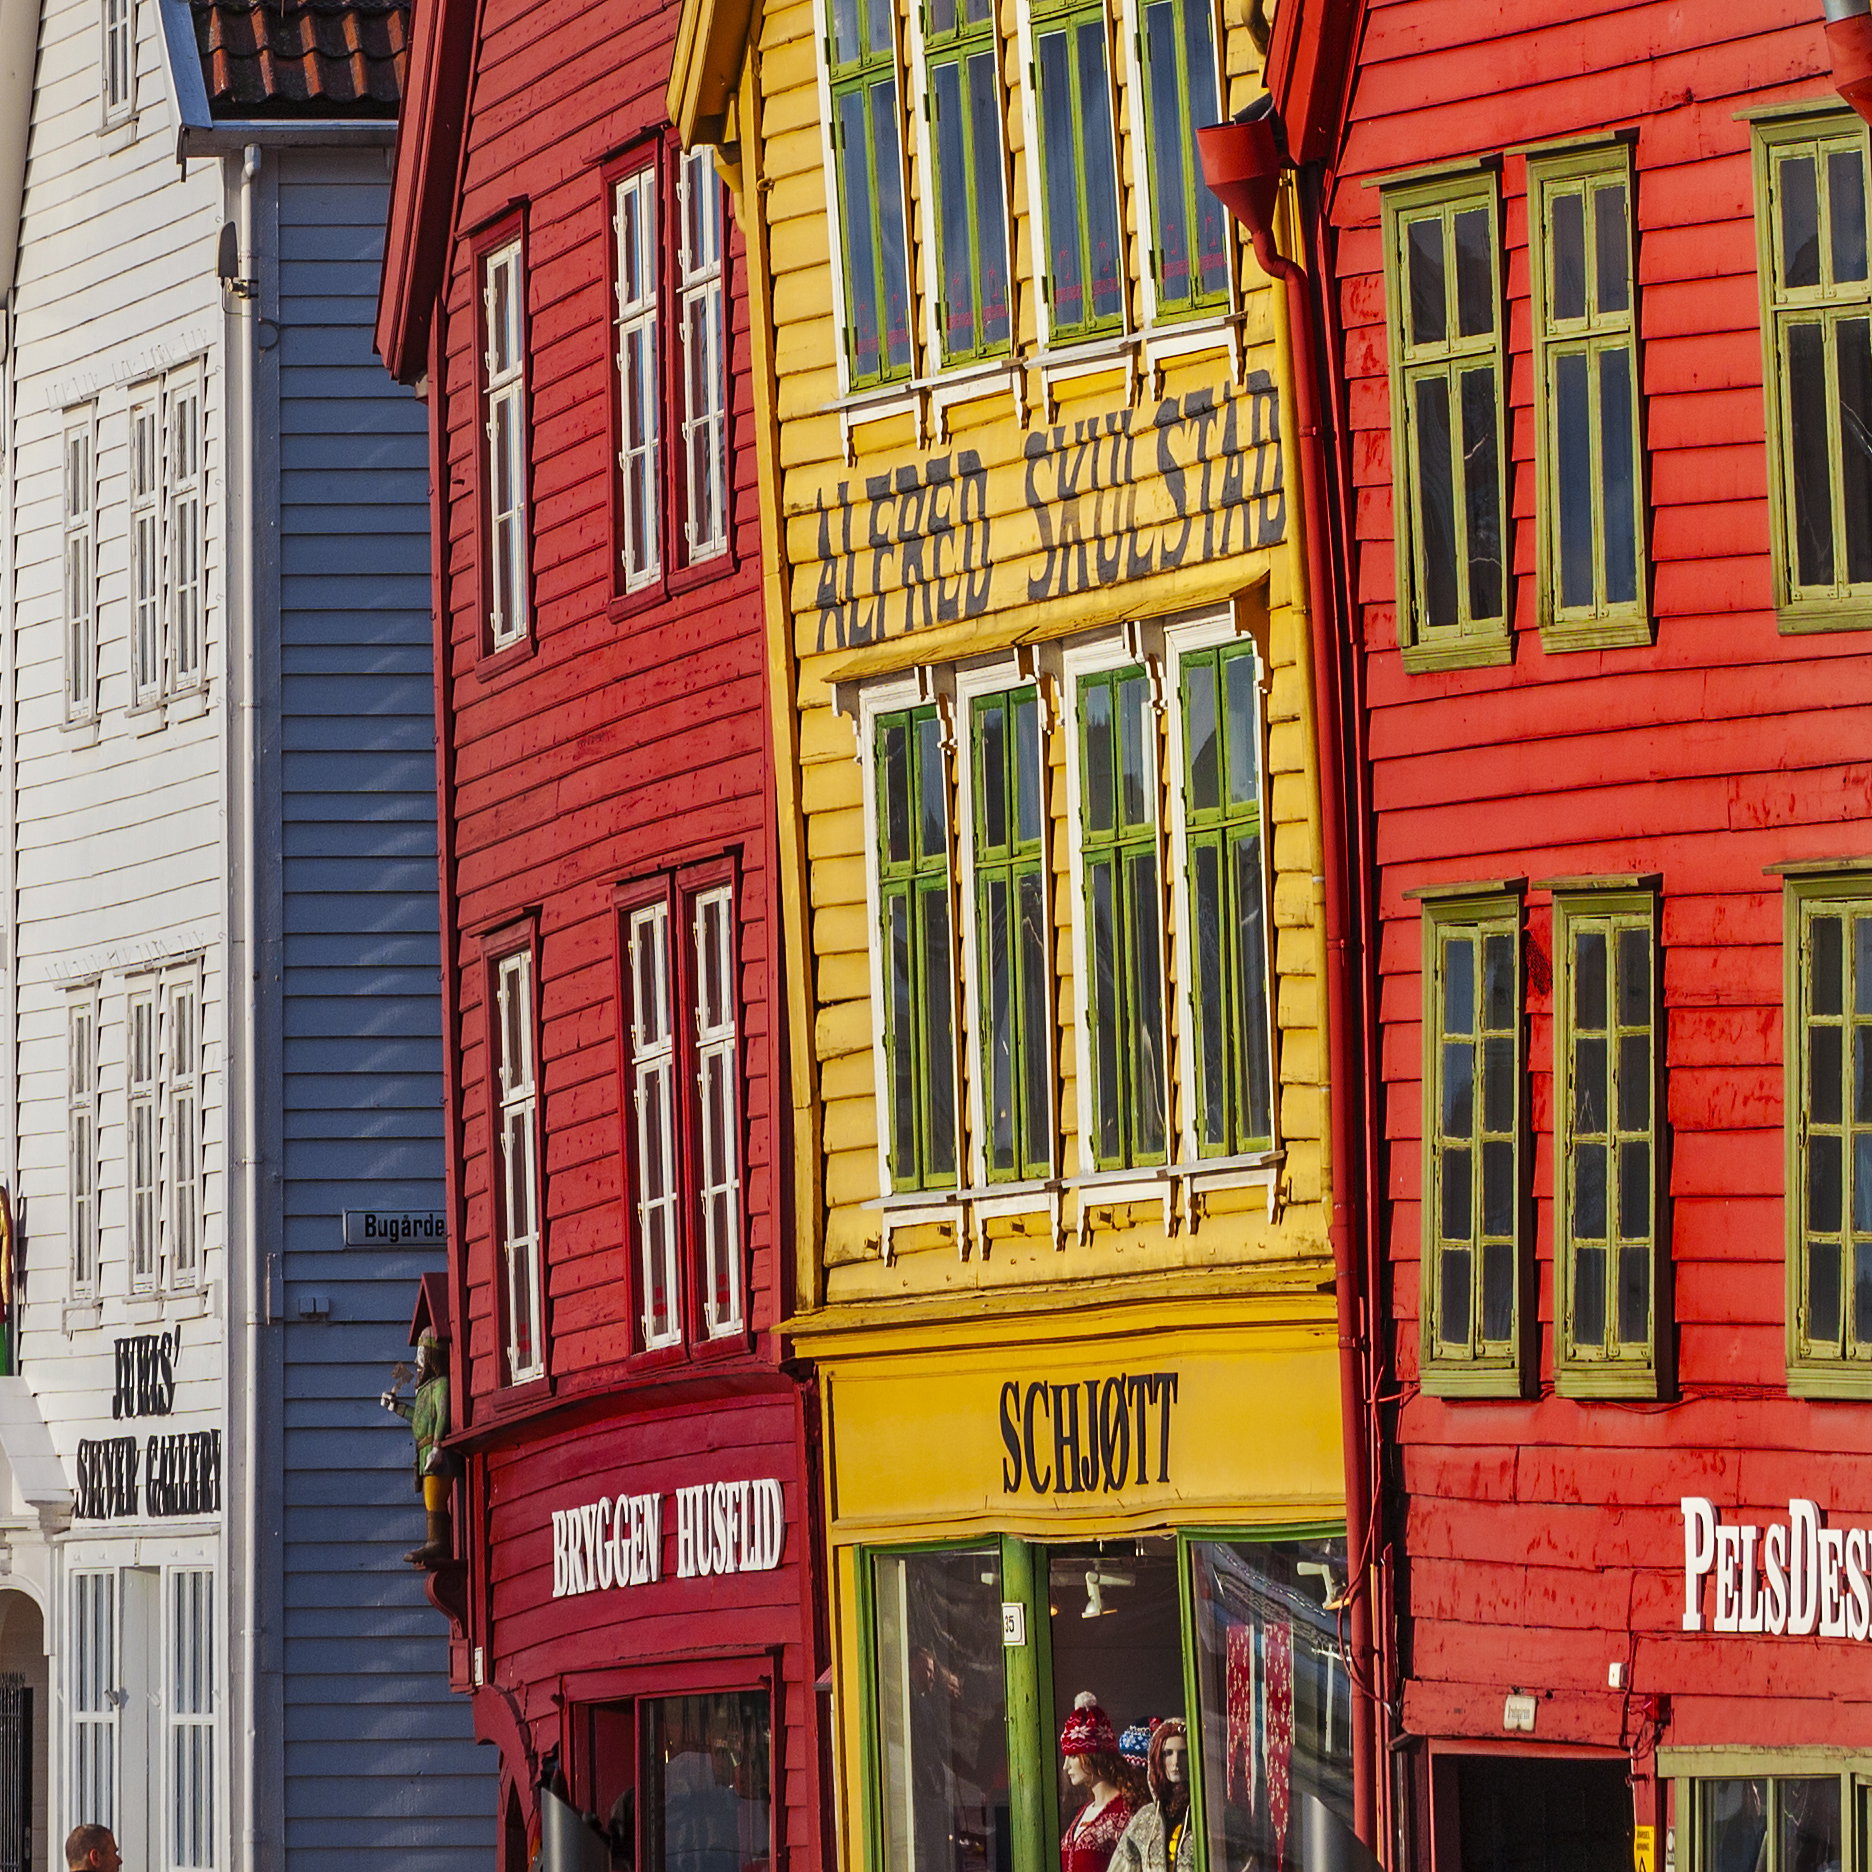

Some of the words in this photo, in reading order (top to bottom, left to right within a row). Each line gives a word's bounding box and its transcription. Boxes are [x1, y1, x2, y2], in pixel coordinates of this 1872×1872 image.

[816, 449, 991, 652] ALFRED
[1024, 369, 1287, 601] SKULSTAD
[999, 1371, 1179, 1495] SCHJØTT
[551, 1492, 662, 1598] BRYGGEN
[675, 1478, 784, 1578] HUSFLID
